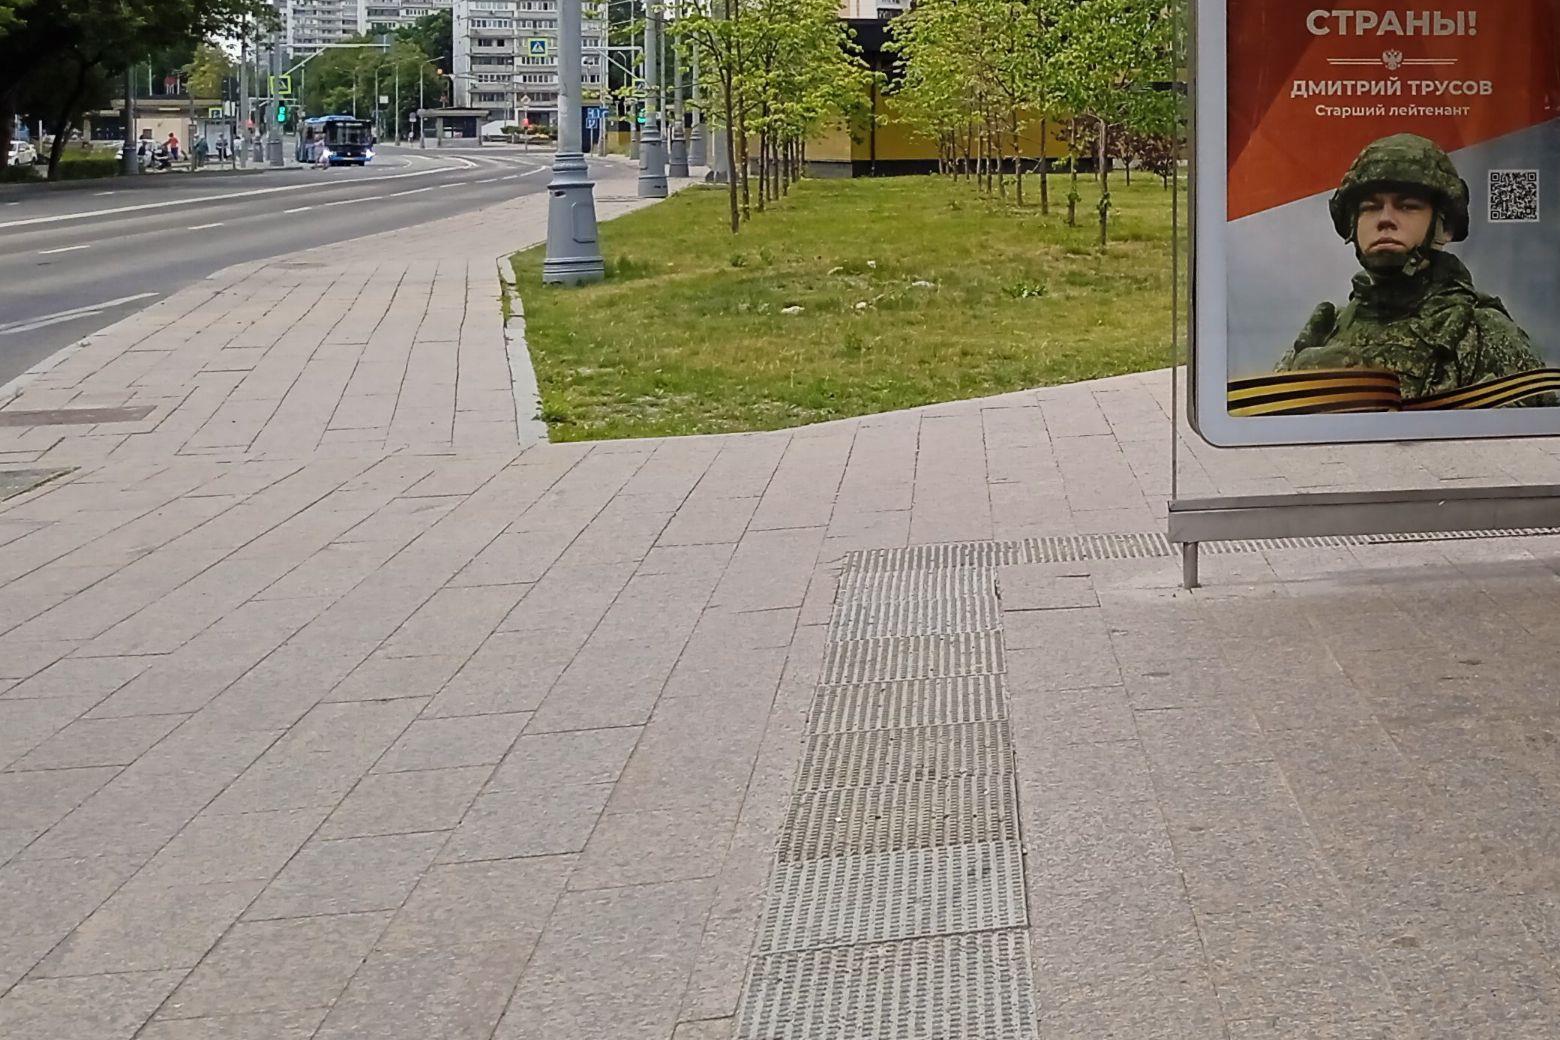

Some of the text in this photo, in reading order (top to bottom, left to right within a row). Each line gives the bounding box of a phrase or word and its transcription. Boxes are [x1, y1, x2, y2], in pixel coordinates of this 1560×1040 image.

[1306, 9, 1477, 37] СТРАНЫ!
[1290, 76, 1493, 99] ДМИТРИЙ ТРУСОВ
[1315, 104, 1470, 119] Старший лейтенант
